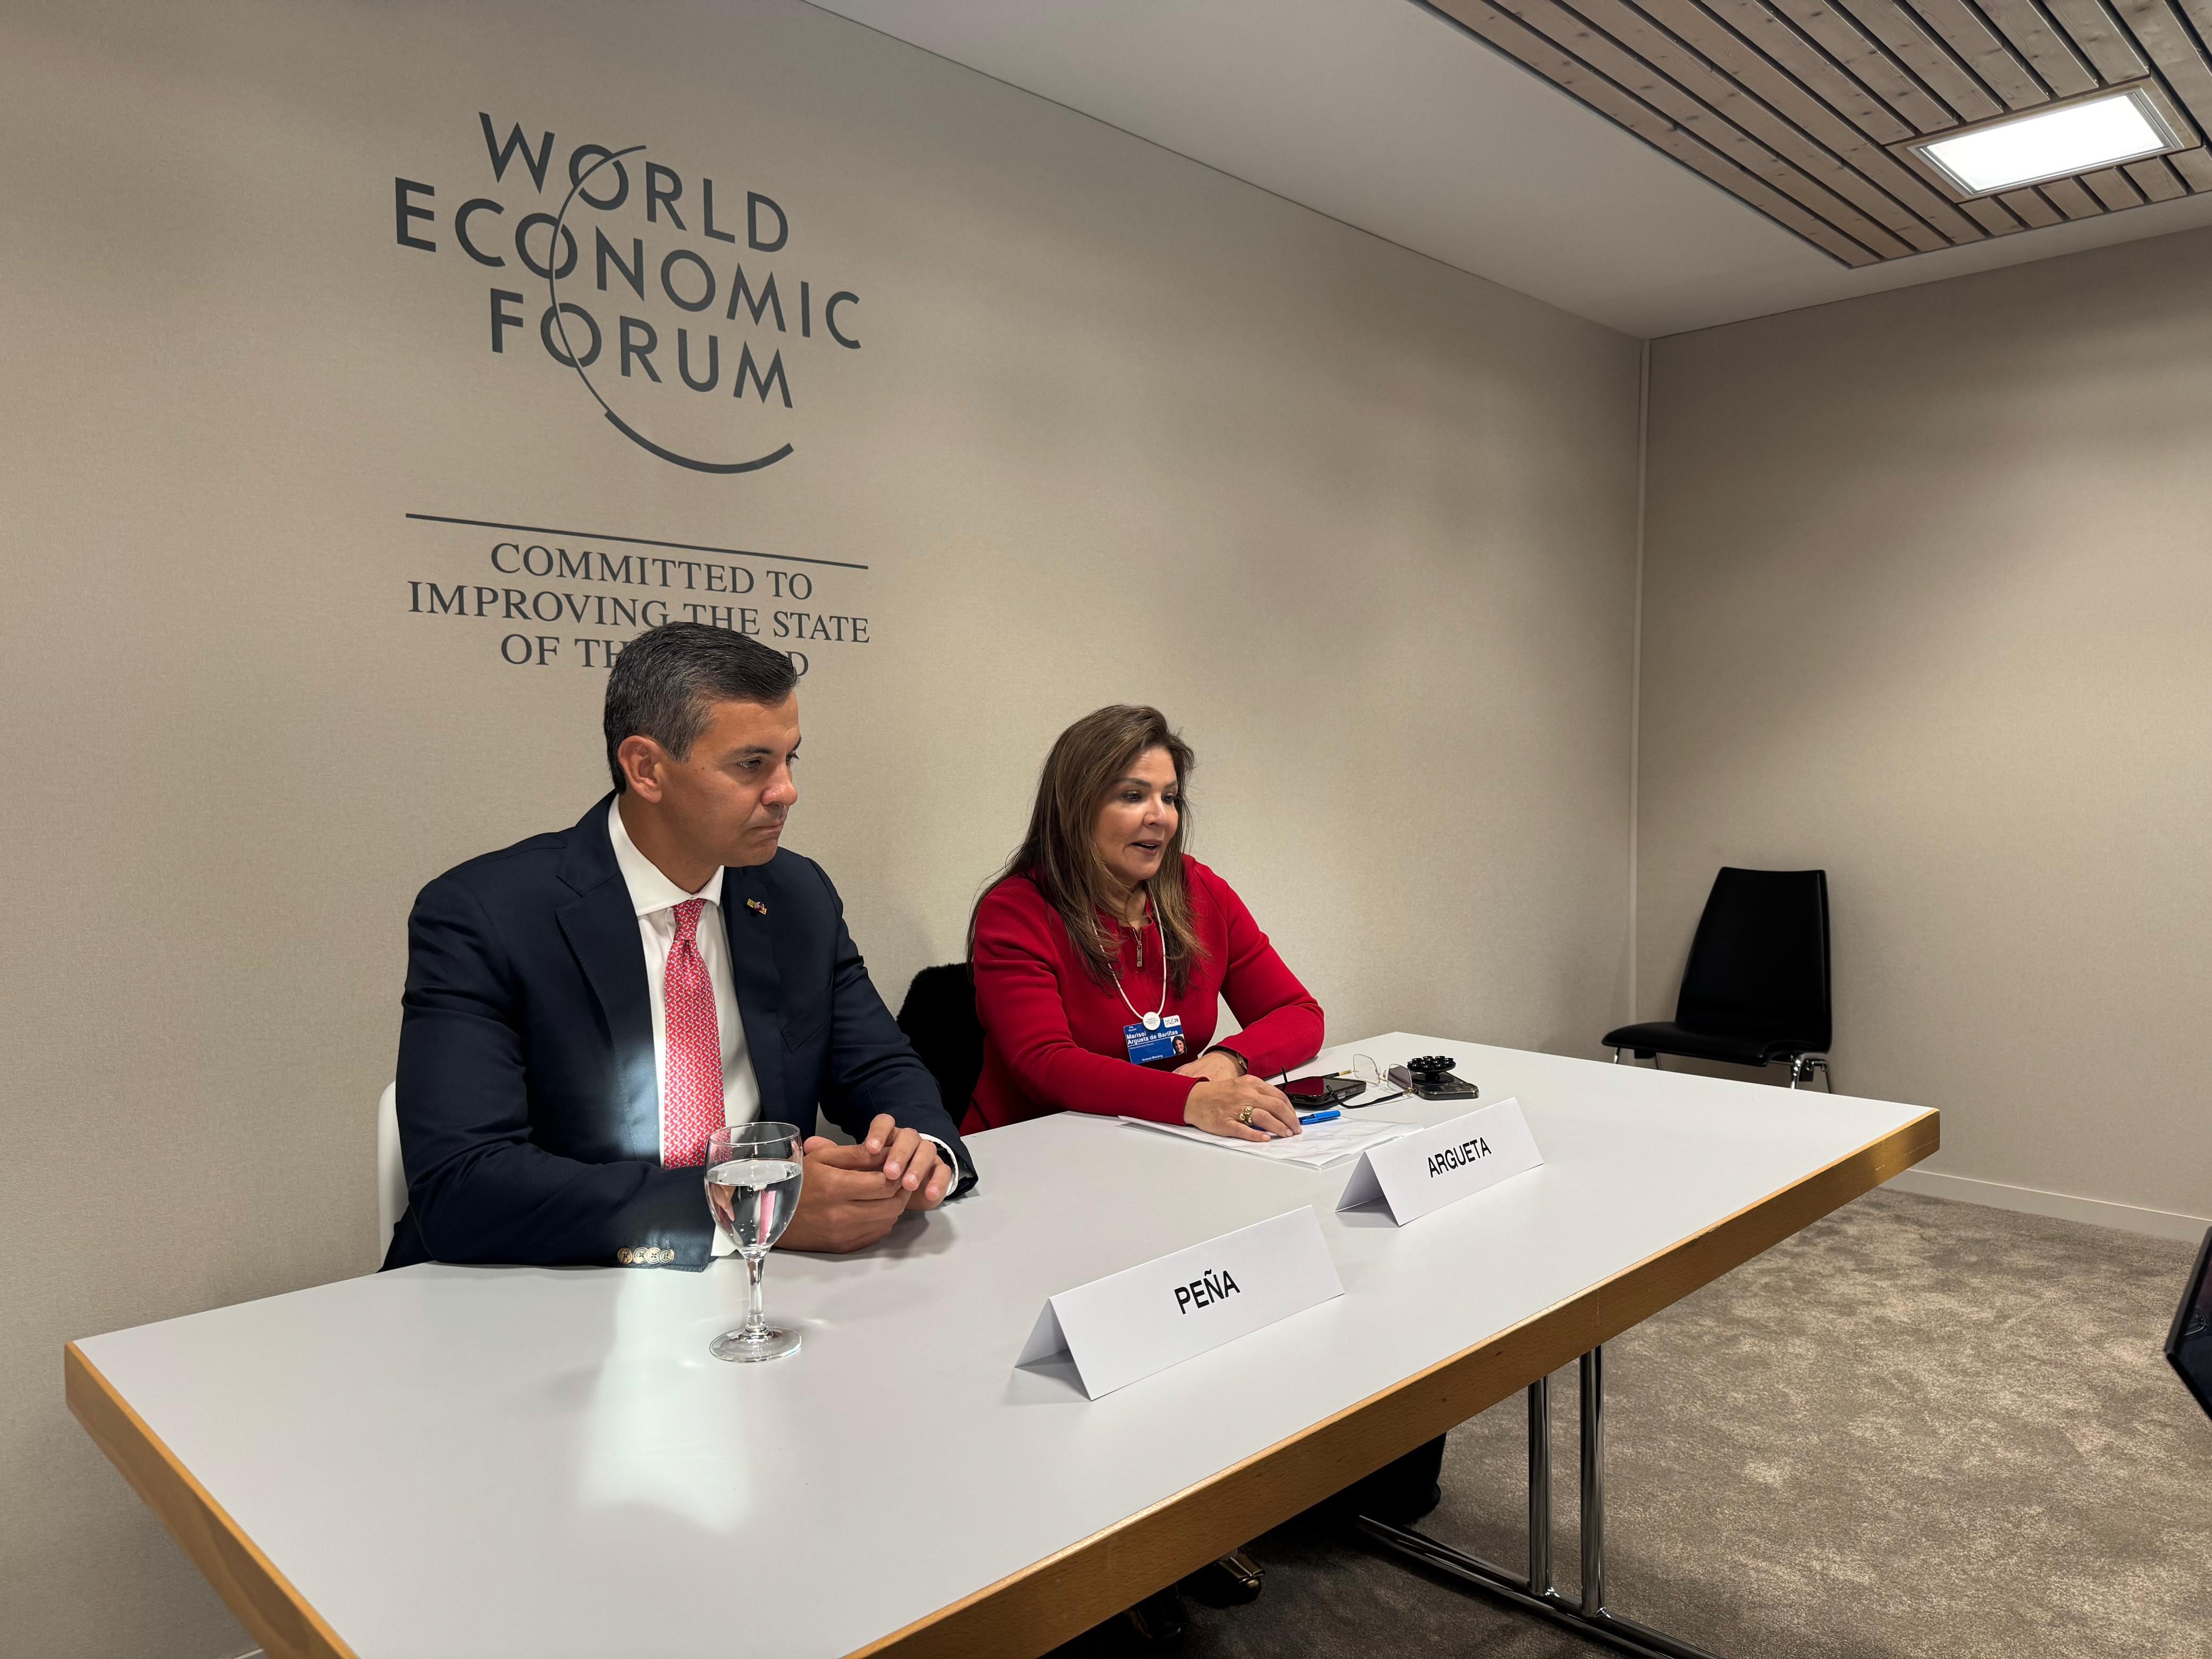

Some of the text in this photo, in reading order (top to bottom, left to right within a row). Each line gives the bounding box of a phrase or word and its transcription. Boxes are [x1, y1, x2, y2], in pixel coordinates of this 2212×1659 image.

[479, 112, 788, 253] WORLD
[395, 177, 861, 349] ECONOMIC
[490, 288, 793, 409] FORUM
[491, 543, 812, 600] COMMITTED TO
[407, 581, 870, 643] IMPROVING THE STATE
[501, 634, 632, 668] OF TH
[1127, 1031, 1146, 1040] Marisol
[1127, 1036, 1149, 1045] Argueta
[1158, 1030, 1178, 1038] Barillas
[1428, 1137, 1493, 1178] ARGUETA
[1174, 1269, 1241, 1314] PEÑA
